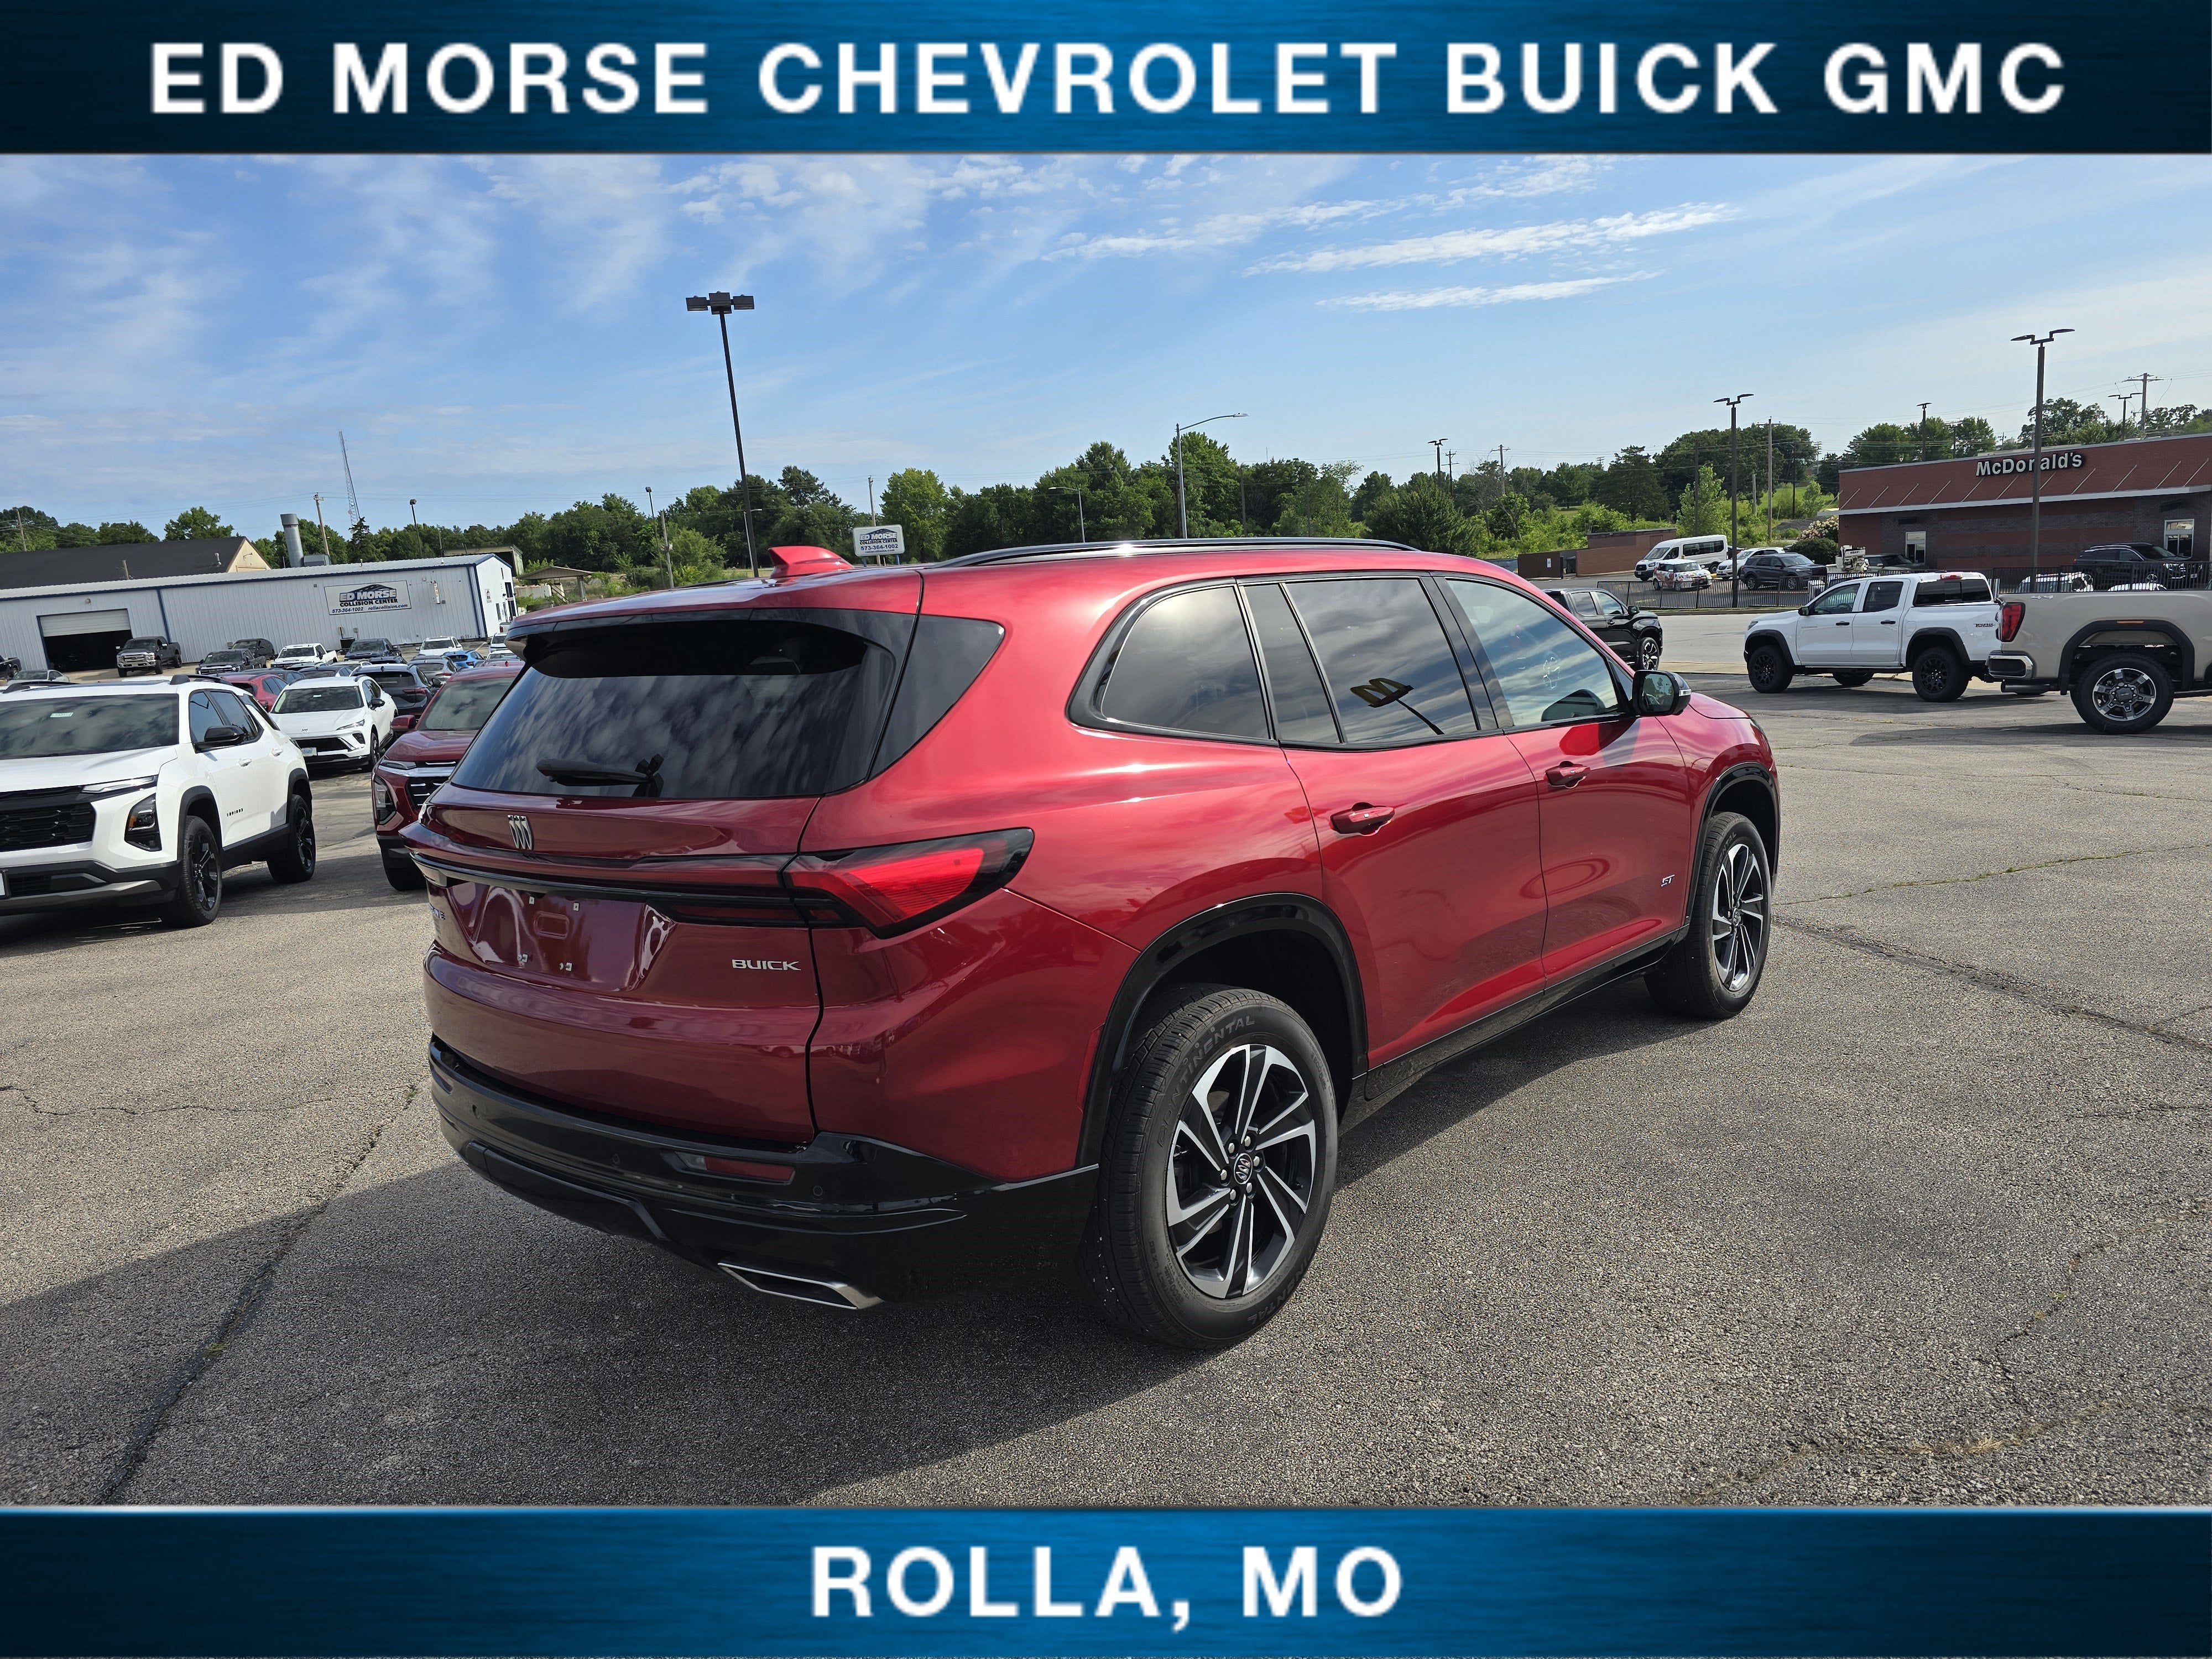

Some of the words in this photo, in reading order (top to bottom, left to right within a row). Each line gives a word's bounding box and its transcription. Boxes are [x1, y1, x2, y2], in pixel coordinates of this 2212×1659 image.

[1976, 452, 2082, 476] McDonald's
[340, 592, 355, 601] ED
[357, 589, 397, 600] MORSE
[732, 959, 802, 971] BUICK
